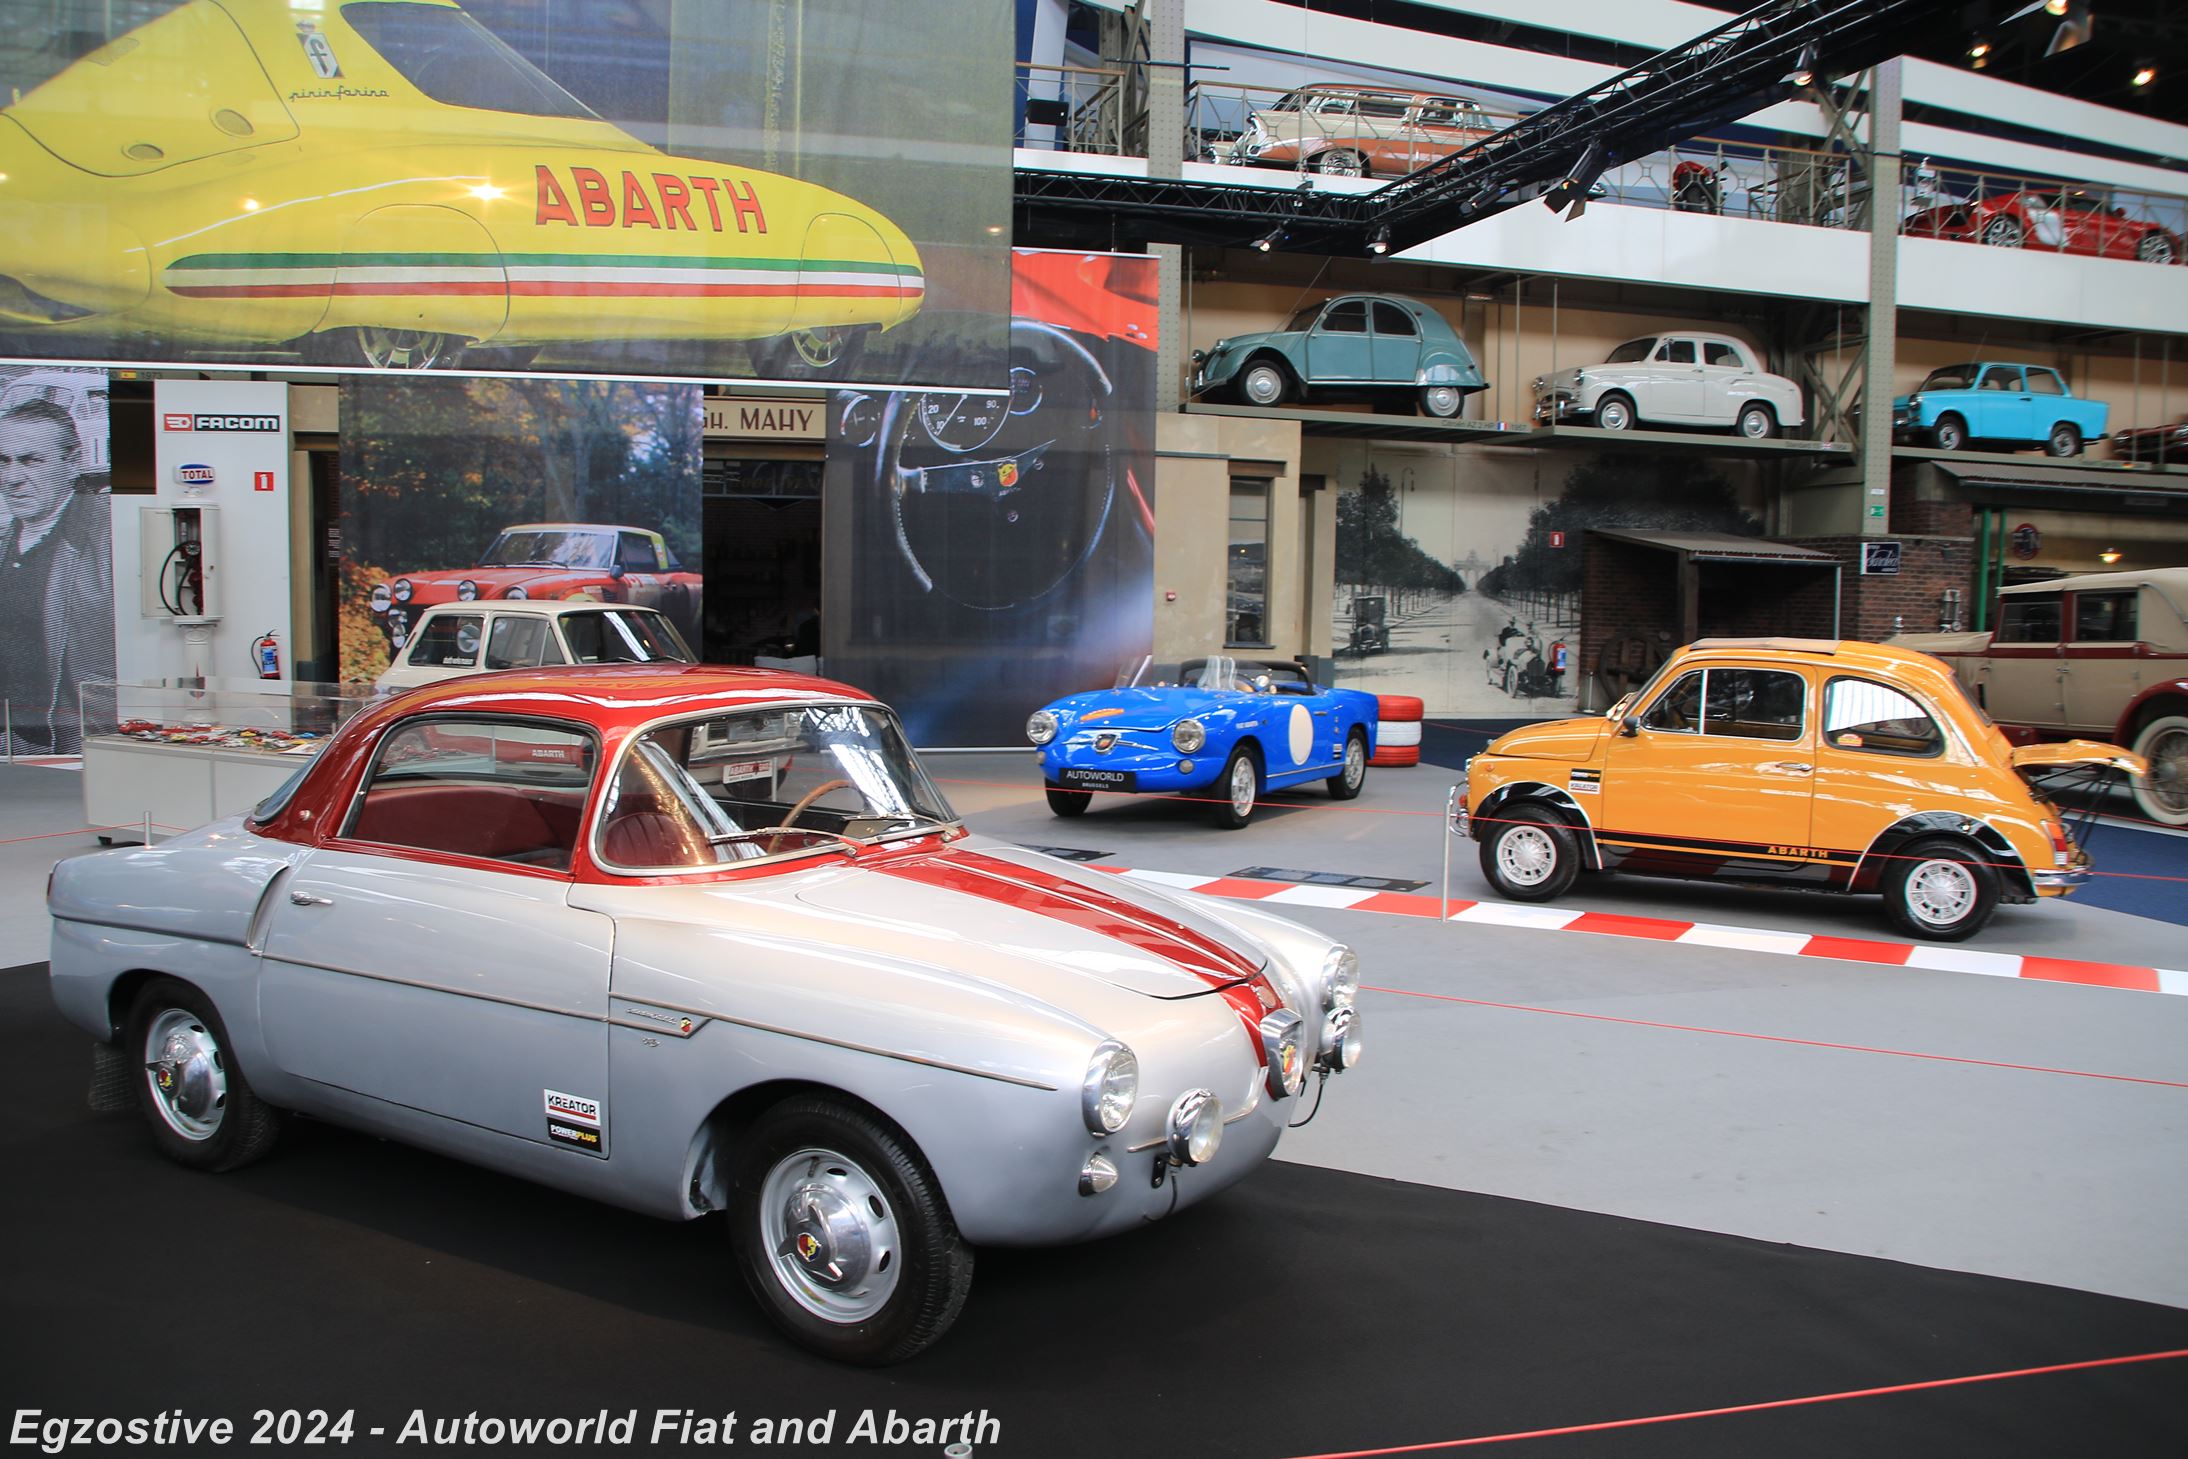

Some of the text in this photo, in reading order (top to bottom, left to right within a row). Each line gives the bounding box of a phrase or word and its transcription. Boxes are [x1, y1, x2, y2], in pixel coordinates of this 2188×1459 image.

[535, 165, 767, 234] ABARTH
[928, 404, 939, 414] 20
[196, 417, 278, 430] FACOM
[741, 408, 813, 431] MAHY
[974, 416, 987, 426] 100
[182, 470, 214, 480] TOTAL
[532, 749, 565, 758] ABARTH
[1066, 770, 1124, 782] AUTOWORLD
[1768, 846, 1828, 858] ABARTH
[548, 1095, 596, 1115] KREATOR
